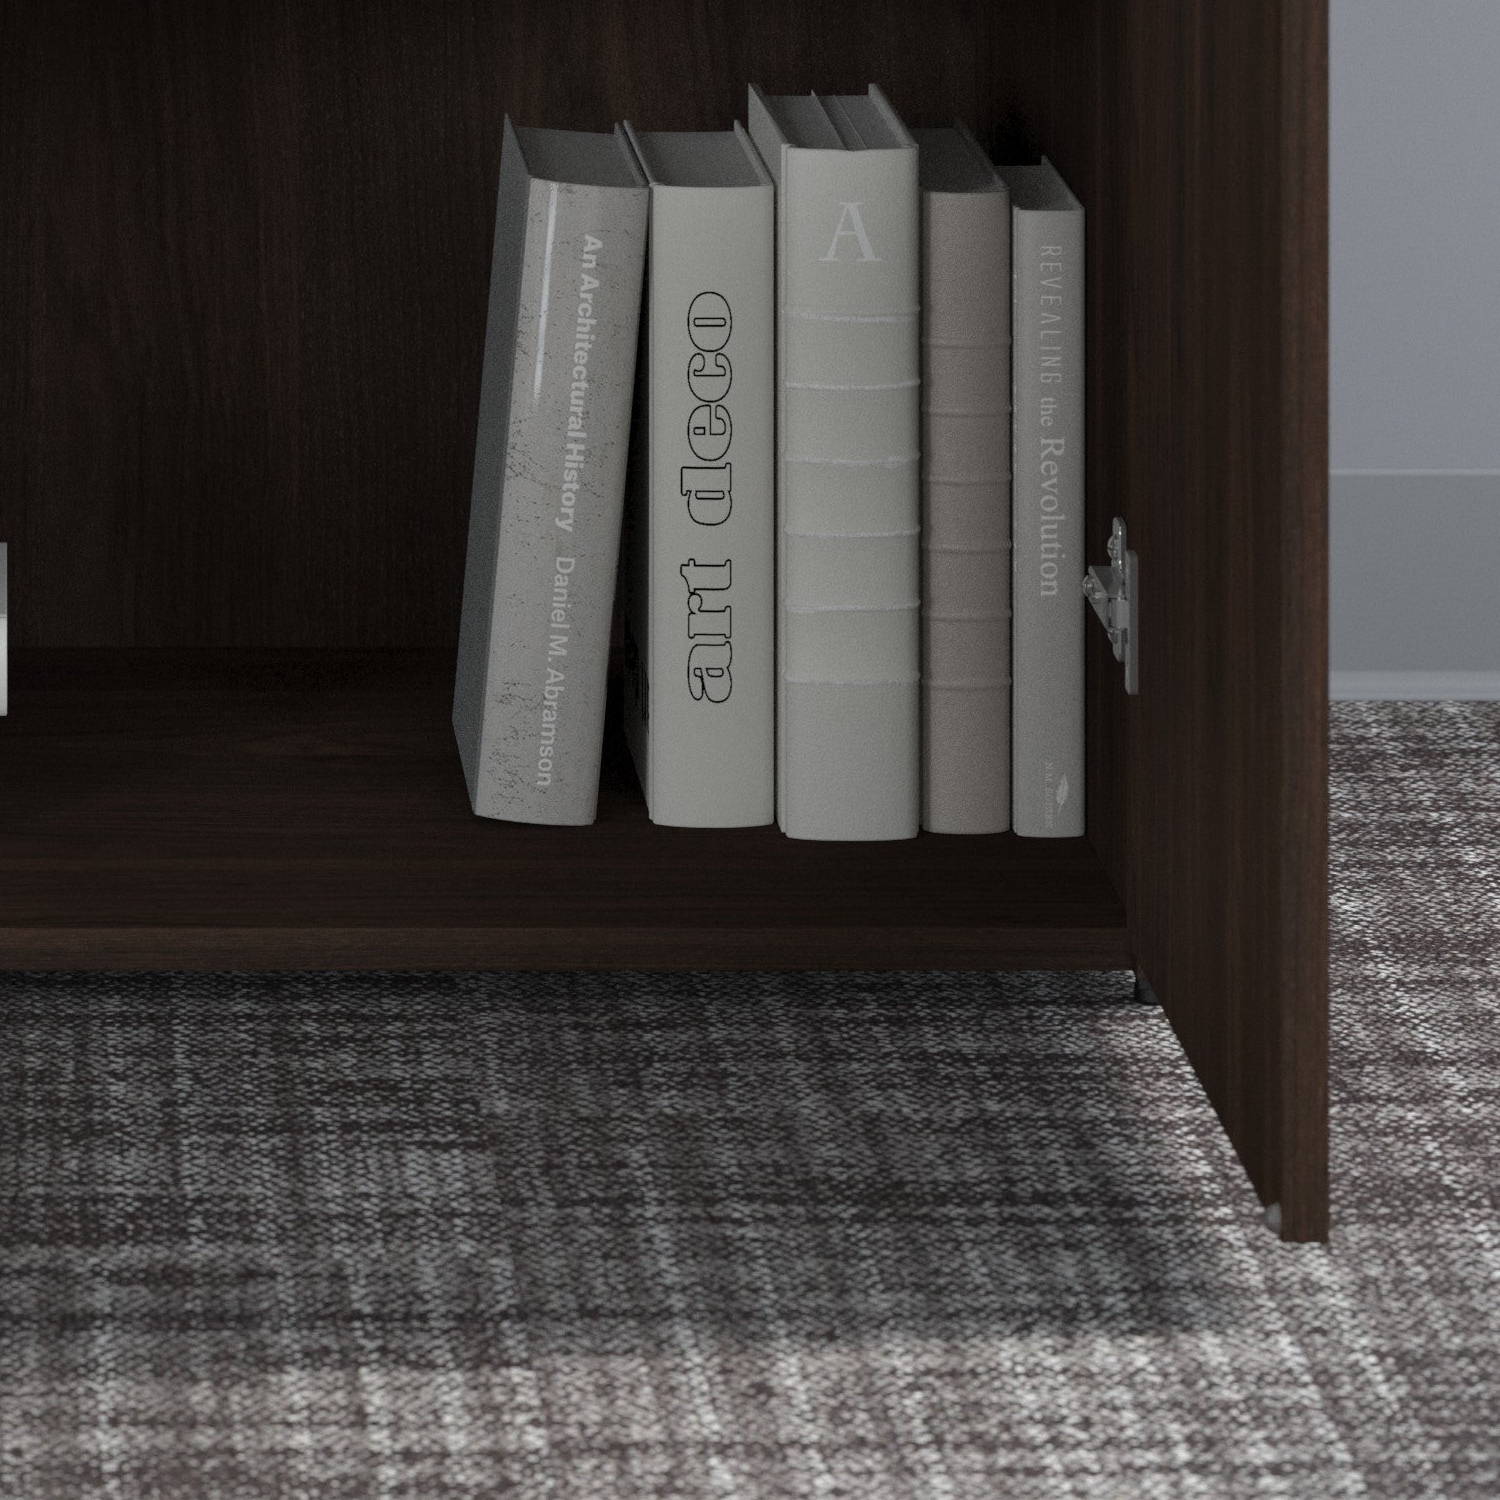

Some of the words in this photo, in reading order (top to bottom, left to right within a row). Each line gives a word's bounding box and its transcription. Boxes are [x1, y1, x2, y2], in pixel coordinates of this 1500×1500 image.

[582, 235, 603, 268] An
[819, 202, 882, 262] A
[567, 273, 601, 437] Architectural
[1040, 245, 1062, 383] REVEALING
[681, 291, 733, 526] deco
[1040, 397, 1060, 427] the
[555, 441, 586, 532] History
[1040, 437, 1067, 597] Revolution
[549, 557, 576, 629] Daniel
[680, 558, 733, 704] art
[547, 635, 568, 663] M.
[536, 669, 566, 787] Abramson
